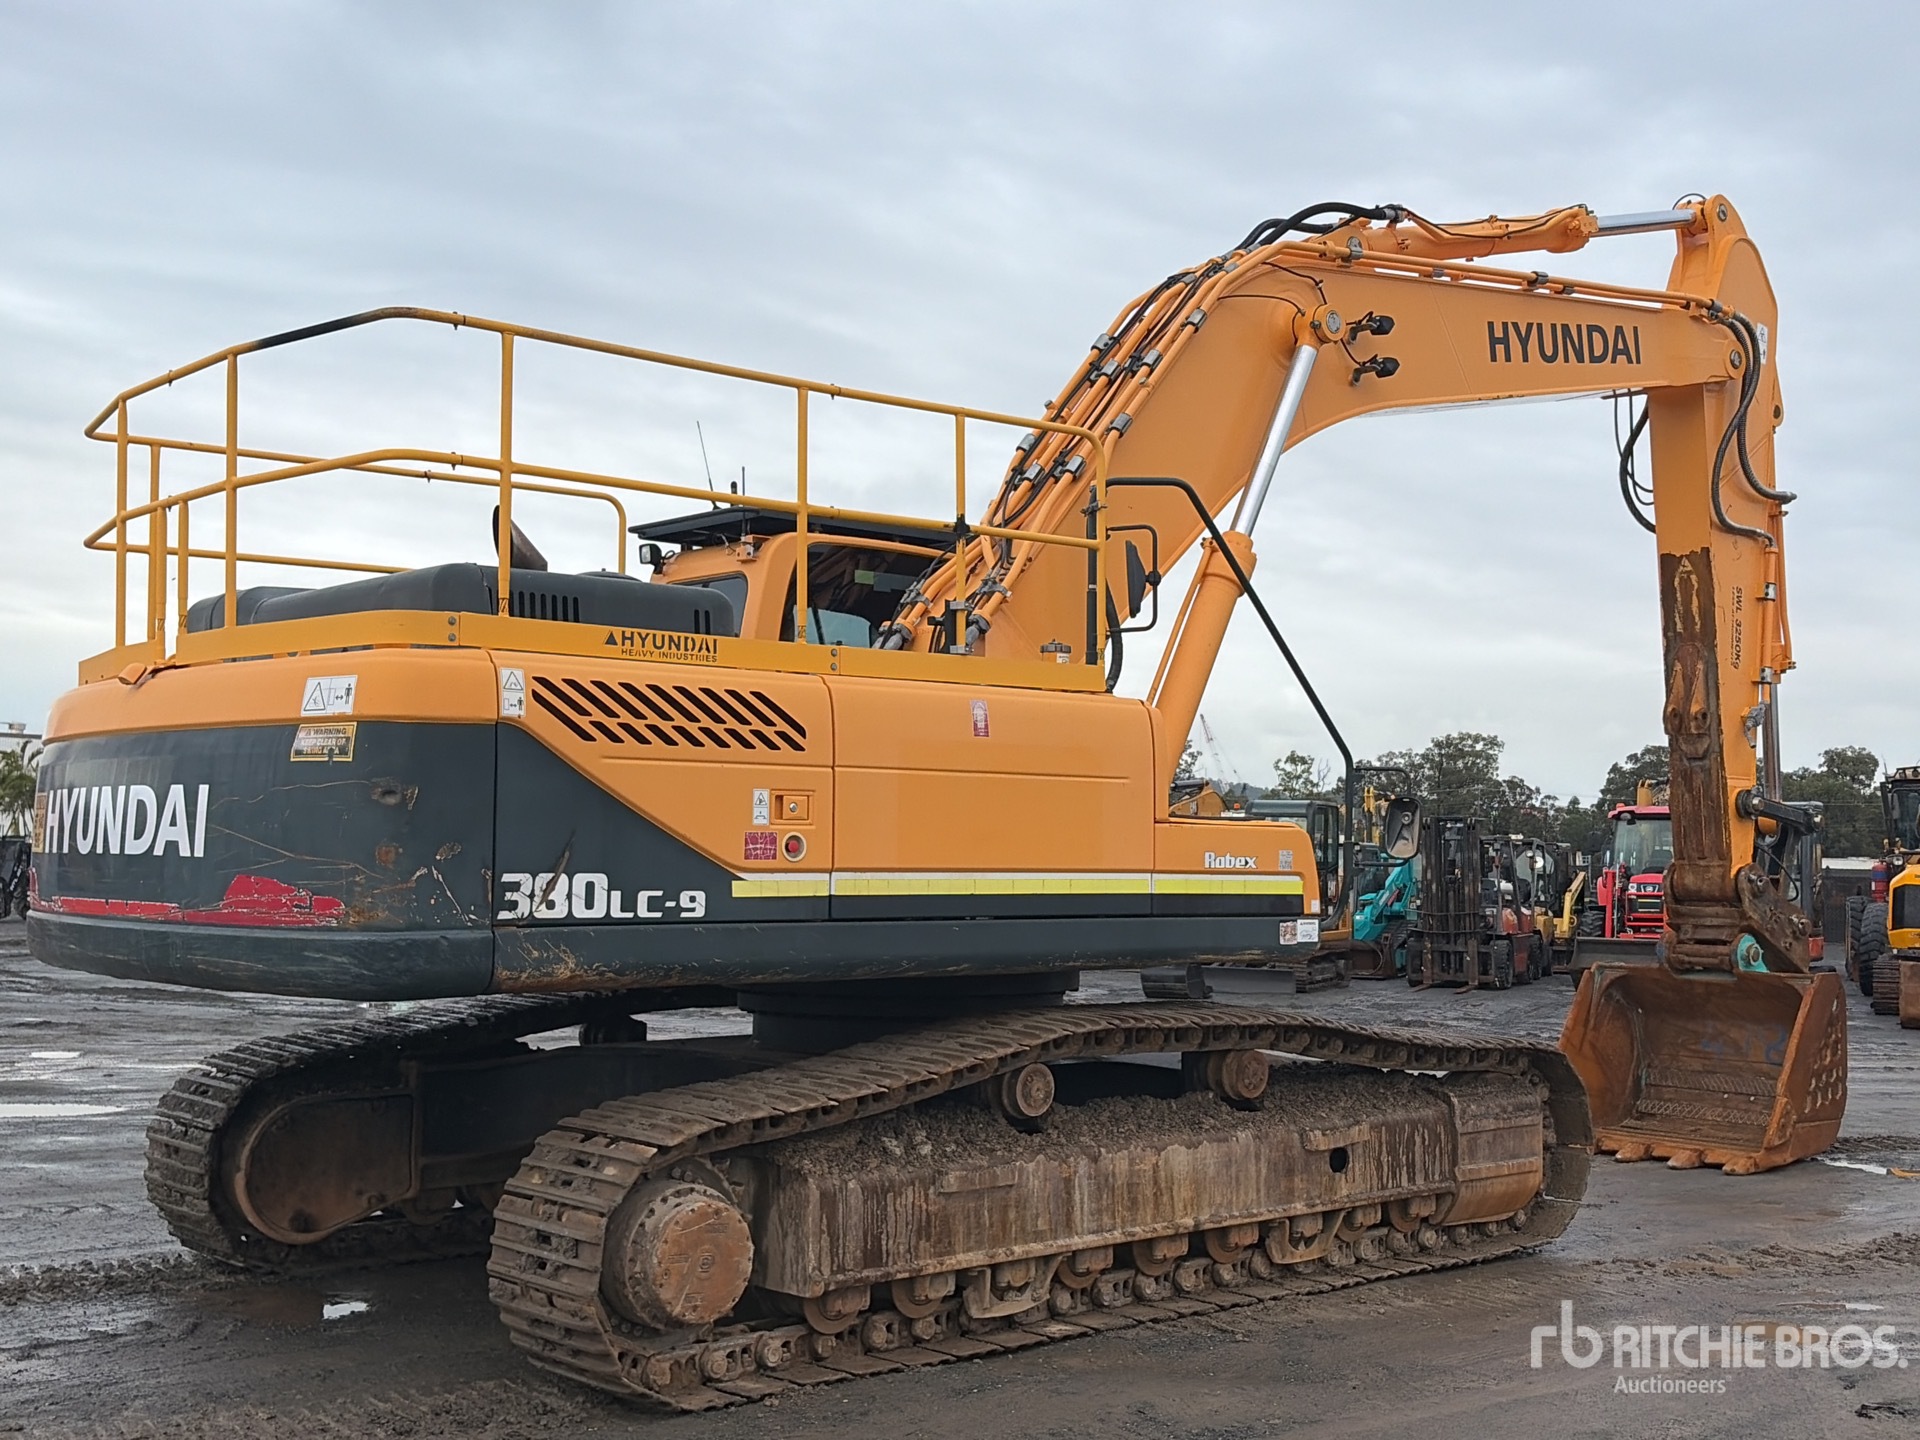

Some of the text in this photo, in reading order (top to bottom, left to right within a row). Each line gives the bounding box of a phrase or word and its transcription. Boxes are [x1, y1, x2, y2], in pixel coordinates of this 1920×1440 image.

[1487, 321, 1641, 364] HYUNDAI
[1735, 586, 1743, 613] SWL
[621, 630, 718, 655] HYUNDAI
[621, 648, 718, 663] HEAVY INDUSTRIES
[313, 727, 347, 736] WARNING
[45, 784, 209, 857] HYUNDAI
[1204, 851, 1257, 869] Robex
